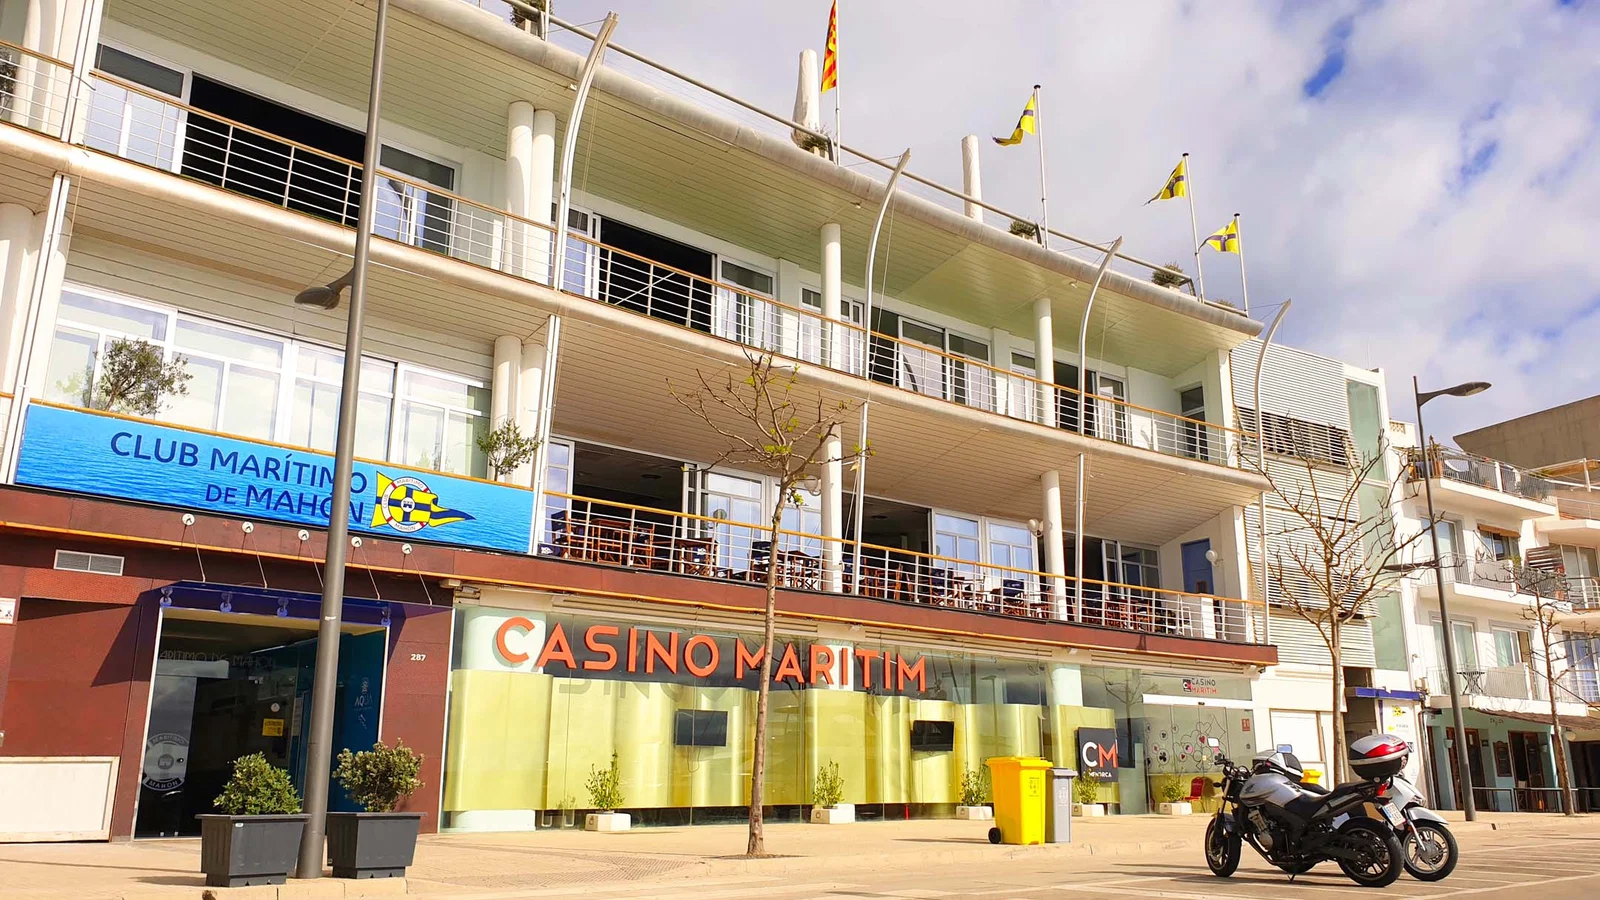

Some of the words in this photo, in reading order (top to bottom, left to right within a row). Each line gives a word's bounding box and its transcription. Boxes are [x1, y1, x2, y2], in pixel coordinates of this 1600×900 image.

[110, 431, 199, 467] CLUB
[205, 484, 238, 505] DE
[410, 653, 427, 662] 287
[495, 616, 719, 678] CASINO
[735, 638, 927, 693] MARITIM
[1191, 678, 1216, 687] CASINO
[1082, 741, 1119, 769] CM
